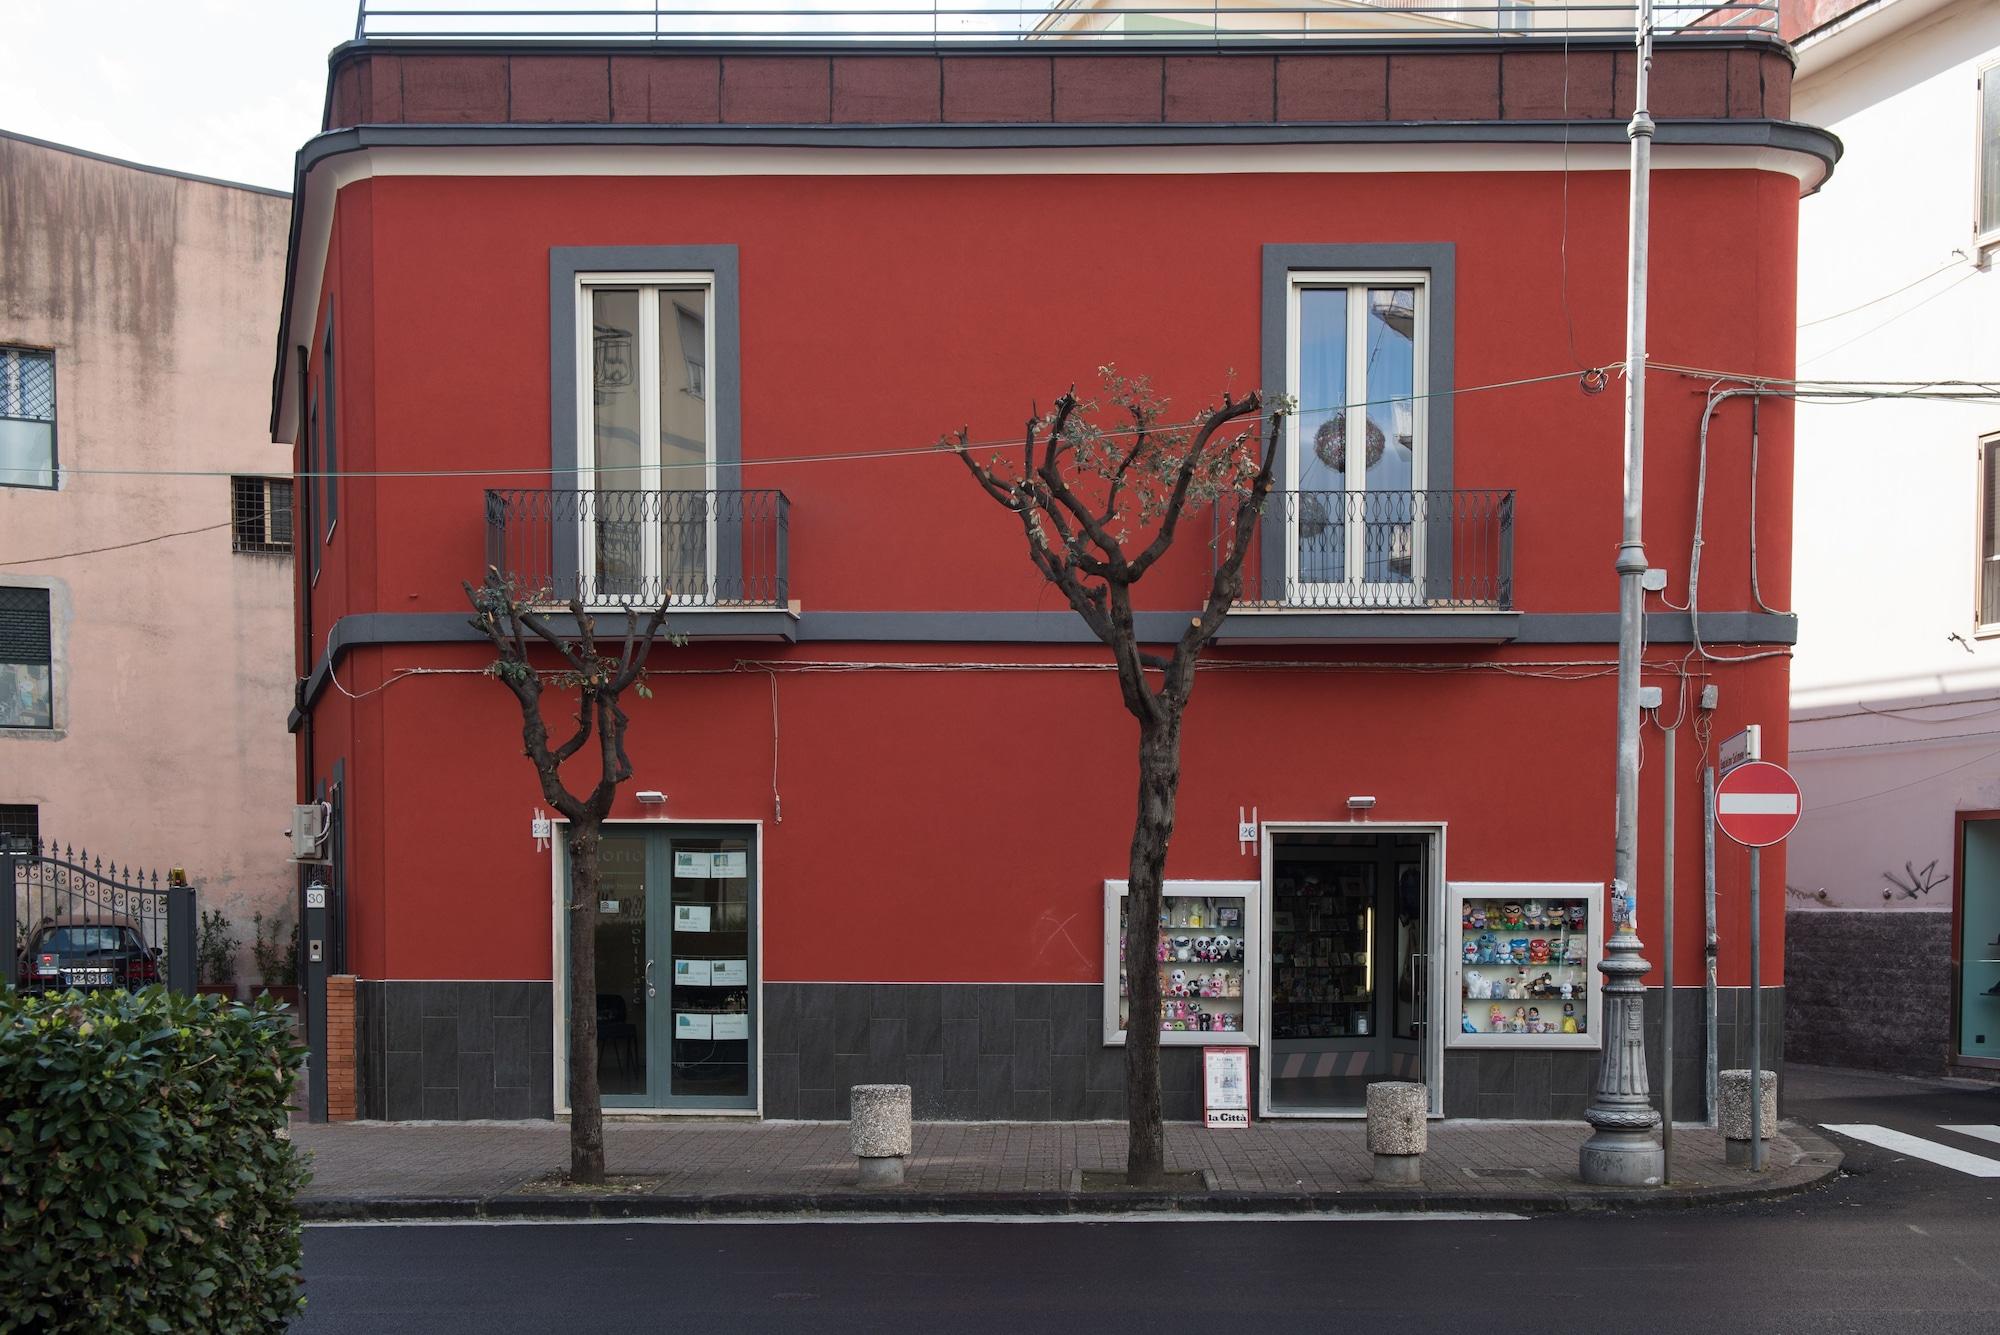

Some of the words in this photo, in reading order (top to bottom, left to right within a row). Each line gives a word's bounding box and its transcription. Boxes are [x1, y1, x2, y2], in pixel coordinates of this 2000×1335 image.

[533, 823, 549, 834] 28
[1241, 826, 1255, 838] 26
[308, 893, 323, 904] 30
[1220, 1113, 1246, 1121] Città
